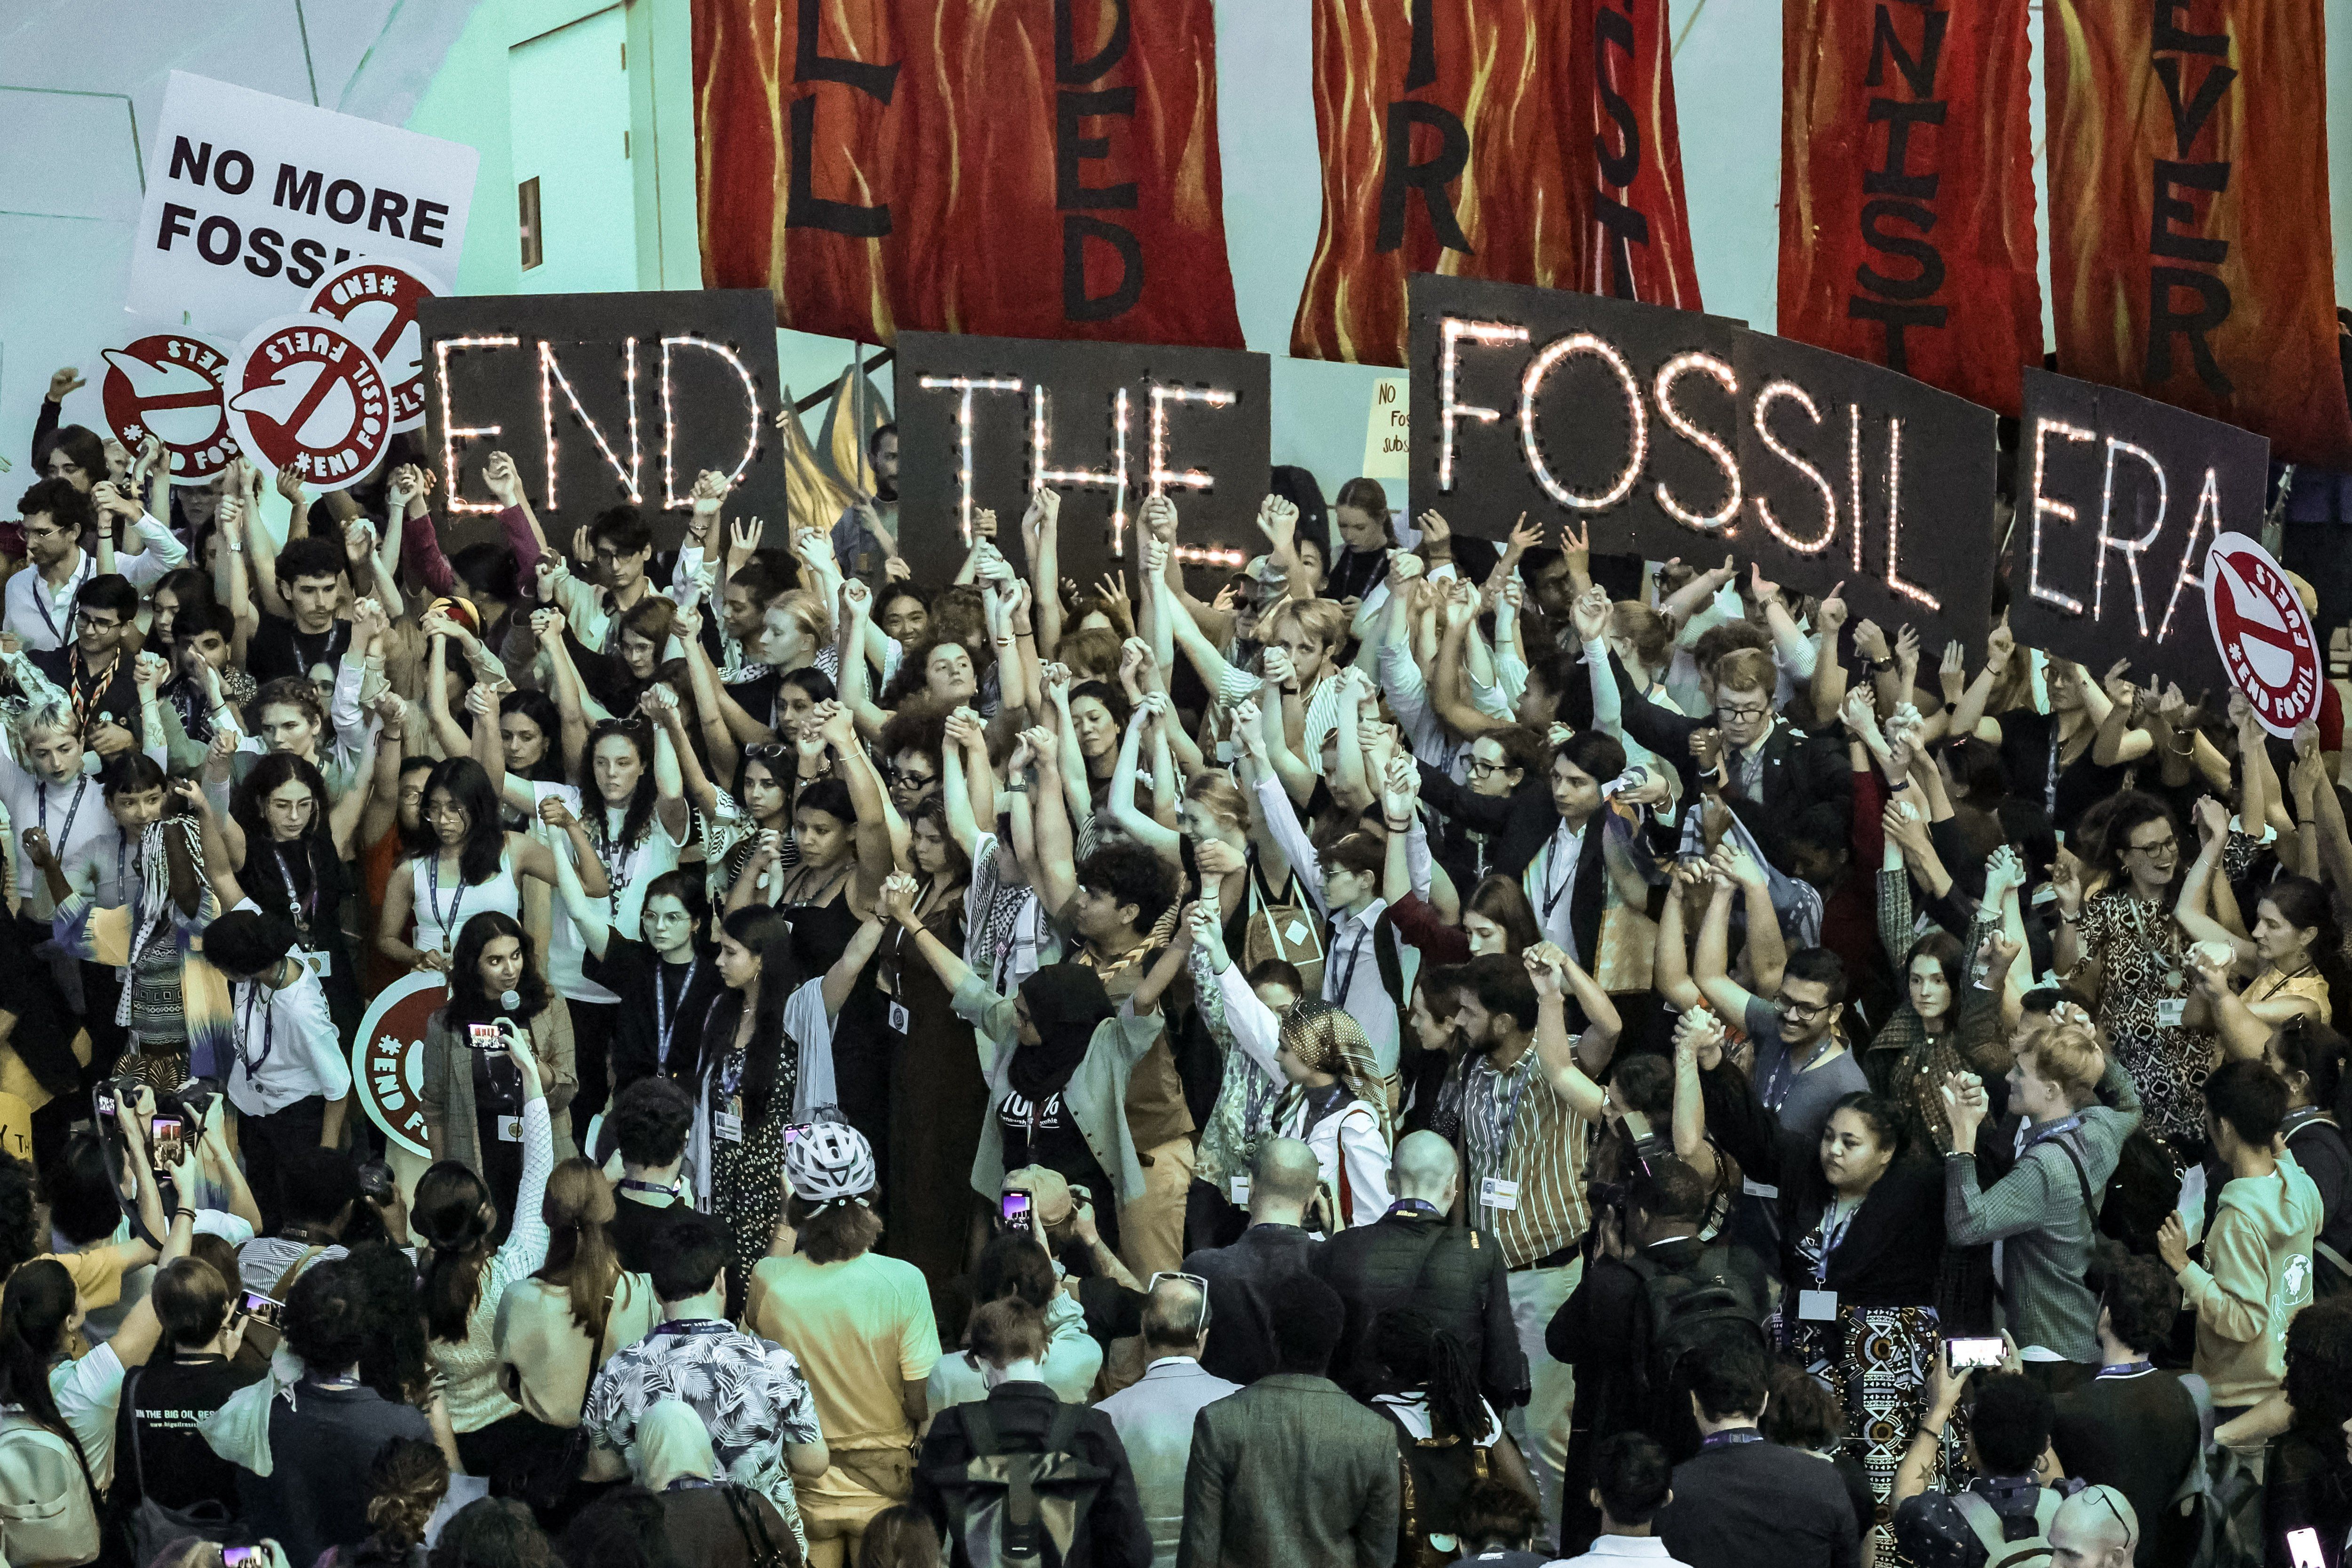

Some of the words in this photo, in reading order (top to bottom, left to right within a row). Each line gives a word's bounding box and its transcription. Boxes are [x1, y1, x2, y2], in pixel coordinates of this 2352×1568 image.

[168, 135, 255, 196] NO
[272, 163, 450, 249] MORE
[1594, 0, 1650, 302] ST
[1849, 0, 1951, 376] NIST
[157, 201, 366, 289] FOSS
[331, 272, 398, 305] #END
[167, 340, 228, 383] UELS
[266, 331, 349, 363] FUELS
[352, 360, 382, 449] FOSSIL
[392, 382, 424, 417] ELS
[435, 336, 761, 511] END
[1378, 382, 1396, 405] NO
[294, 448, 360, 477] #END
[919, 376, 1246, 566] THE
[1438, 317, 1943, 612] FOSSIL
[2030, 417, 2221, 645] ERA
[2256, 563, 2310, 648] FUELS
[2229, 643, 2269, 712] #END
[2274, 666, 2314, 720] FOSSIL
[373, 1034, 405, 1111] #END
[145, 1409, 162, 1419] THE
[164, 1410, 179, 1419] BIG
